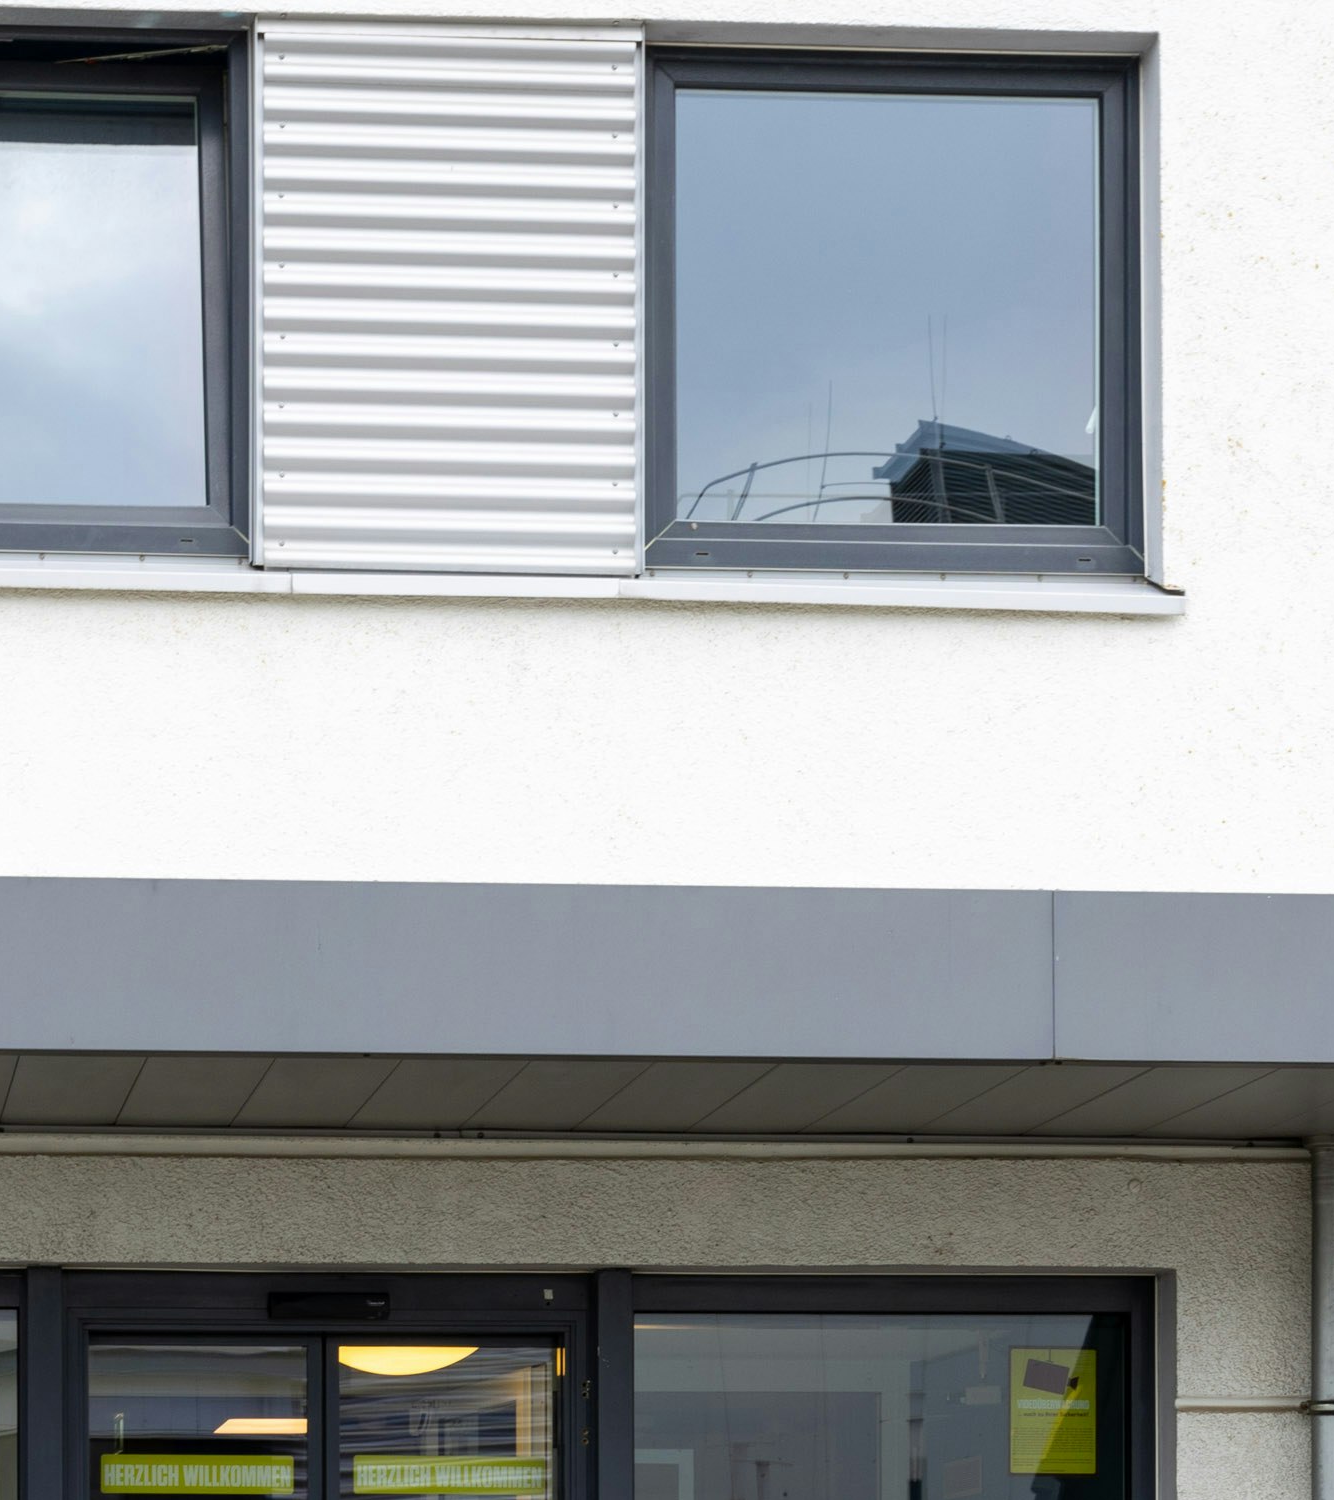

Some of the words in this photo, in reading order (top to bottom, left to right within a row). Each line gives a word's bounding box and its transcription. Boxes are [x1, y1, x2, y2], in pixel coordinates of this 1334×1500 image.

[104, 1464, 179, 1488] HERZLICH
[183, 1464, 292, 1489] WILLKOMMEN
[356, 1464, 431, 1488] HERZLICH
[435, 1464, 543, 1489] WILLKOMMEN
